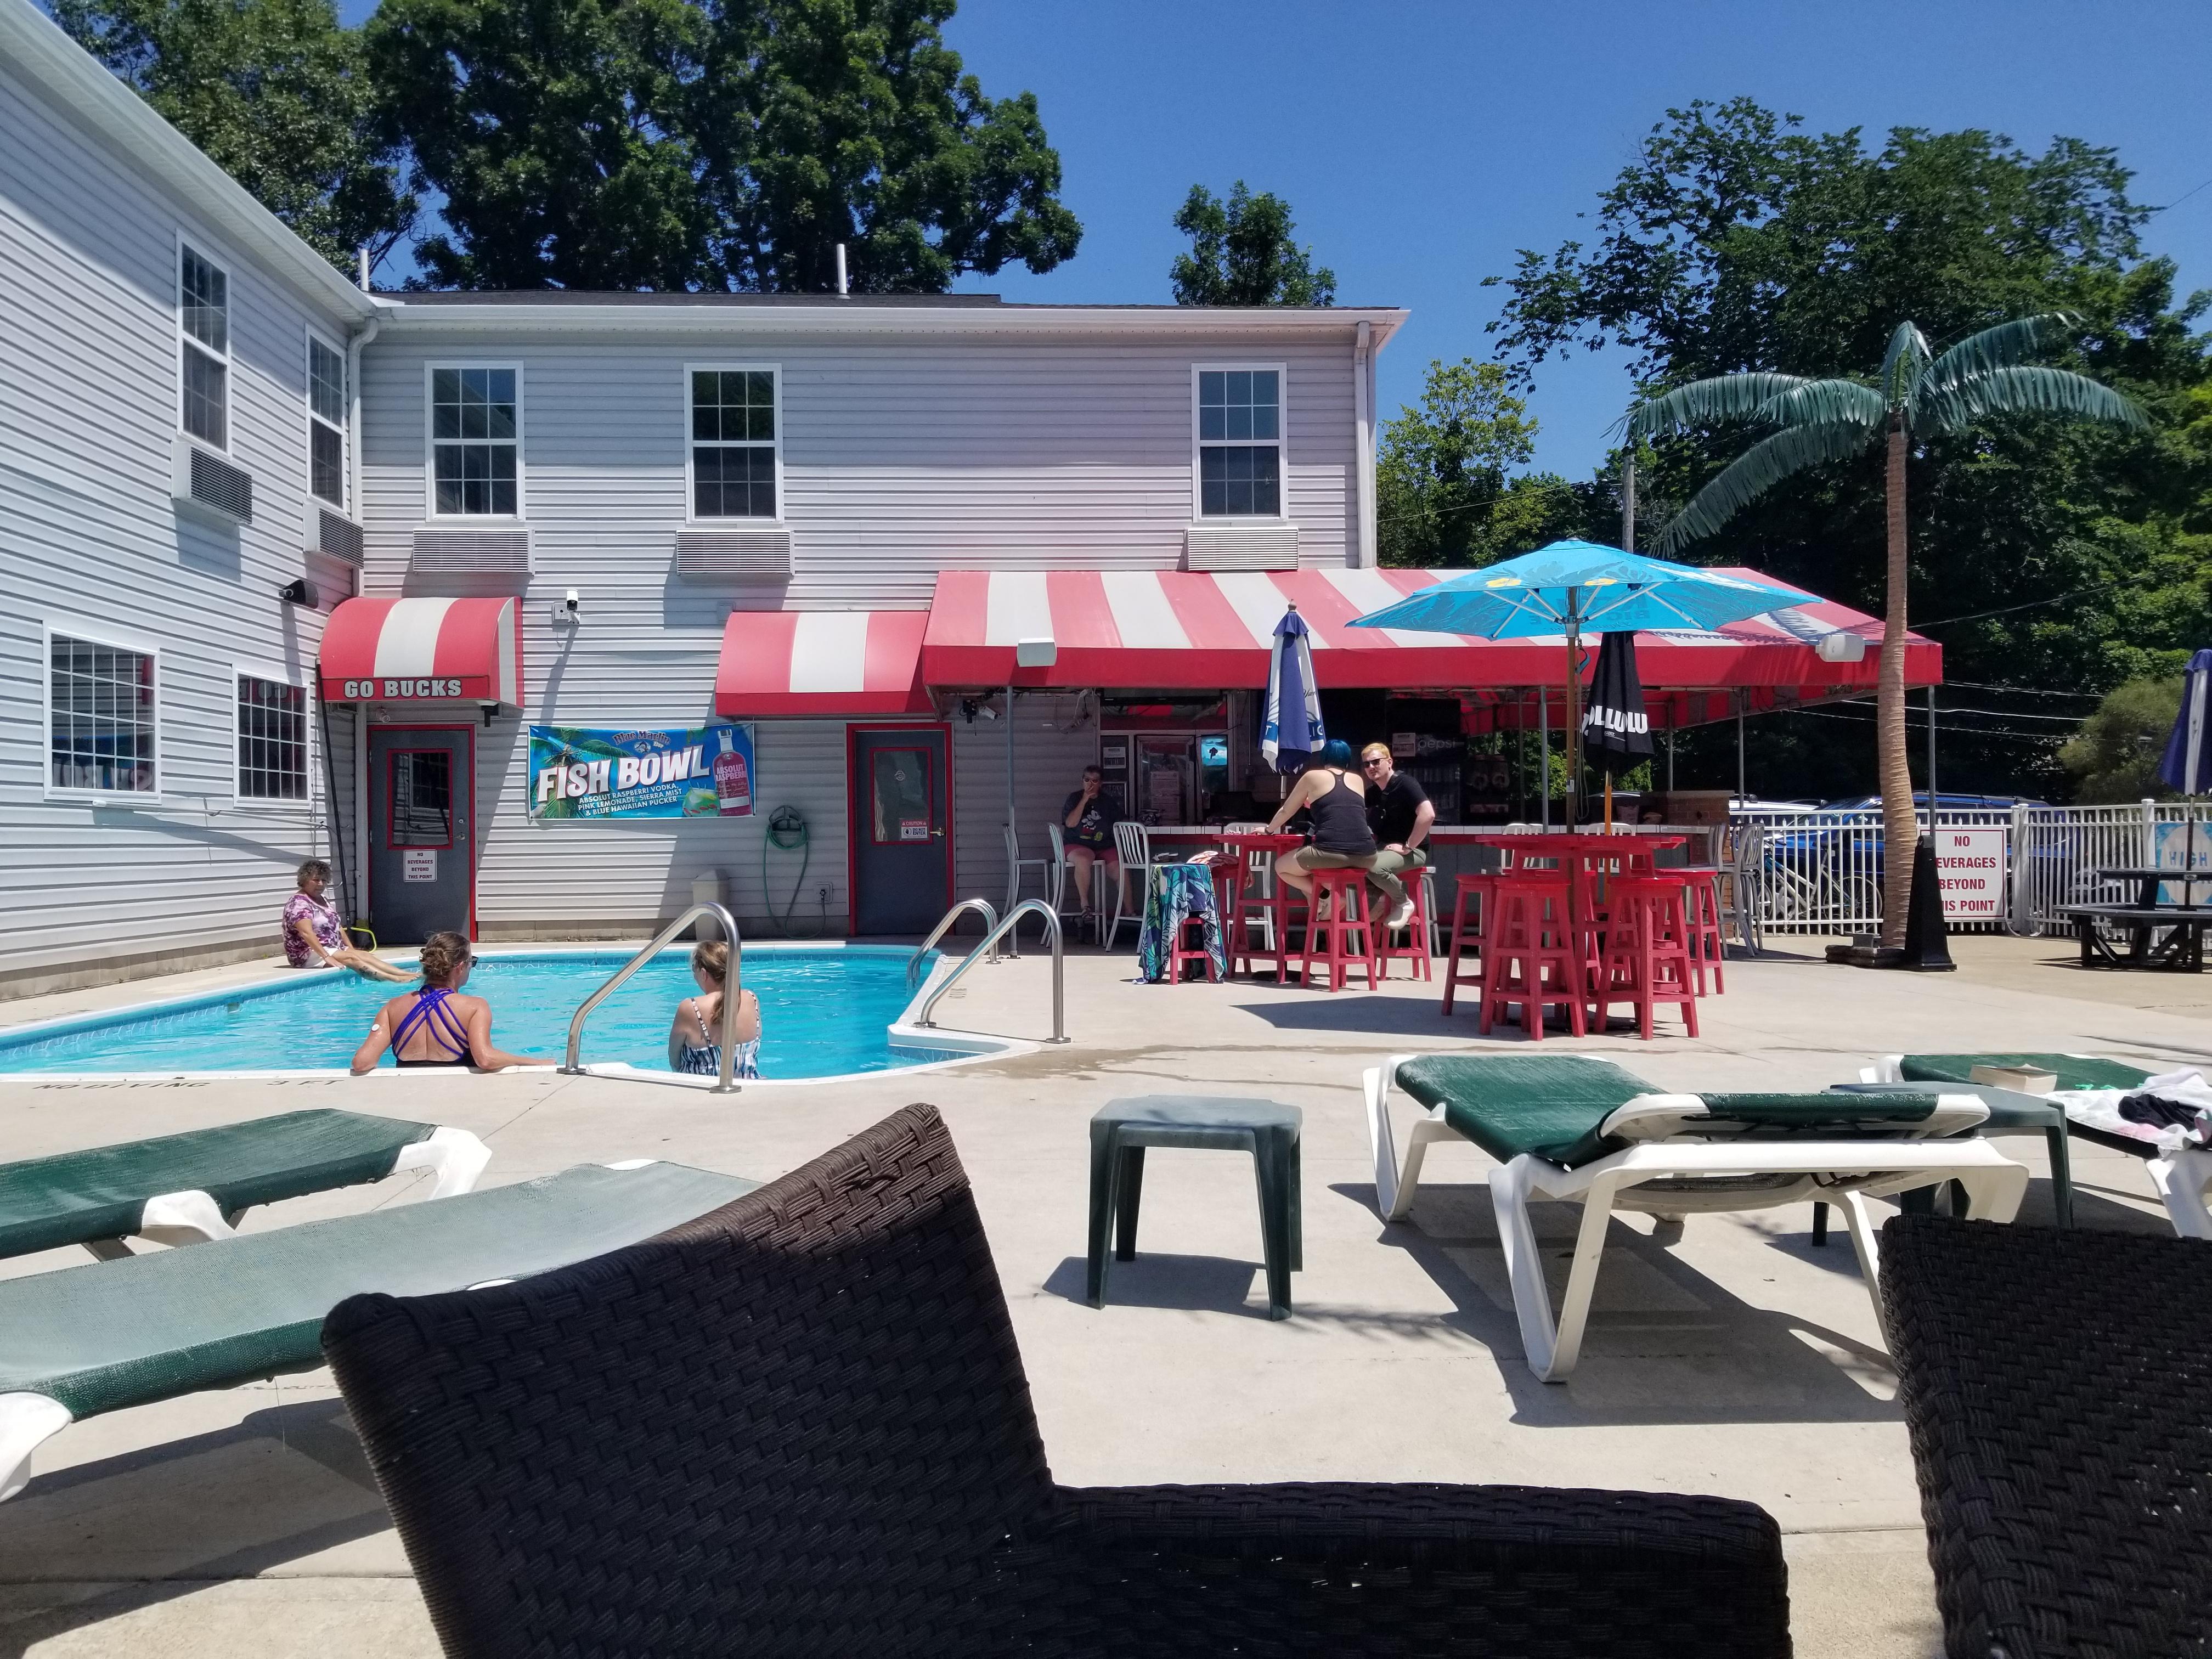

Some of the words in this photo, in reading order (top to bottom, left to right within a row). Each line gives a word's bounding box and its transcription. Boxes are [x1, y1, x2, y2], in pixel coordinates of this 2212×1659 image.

[345, 680, 374, 698] GO
[383, 679, 461, 698] BUCKS
[612, 732, 637, 745] Blue
[637, 730, 671, 745] Marlin
[1418, 738, 1455, 751] pepsi
[537, 759, 611, 803] FISH
[617, 744, 710, 791] BOWL
[716, 764, 744, 775] ABSOLUT
[578, 802, 595, 811] PINK
[640, 792, 664, 801] SIERRA
[665, 788, 682, 797] MIST
[579, 793, 611, 804] ABSOLUT
[612, 787, 650, 799] RASPBERRI
[650, 783, 679, 792] VODKA,
[611, 802, 648, 812] HAWAIIAN
[650, 797, 678, 806] PUCKER
[1954, 836, 1970, 847] NO
[1936, 857, 1996, 868] EVERAGES
[1938, 879, 1985, 890] BEYOND
[1960, 900, 1995, 911] POINT
